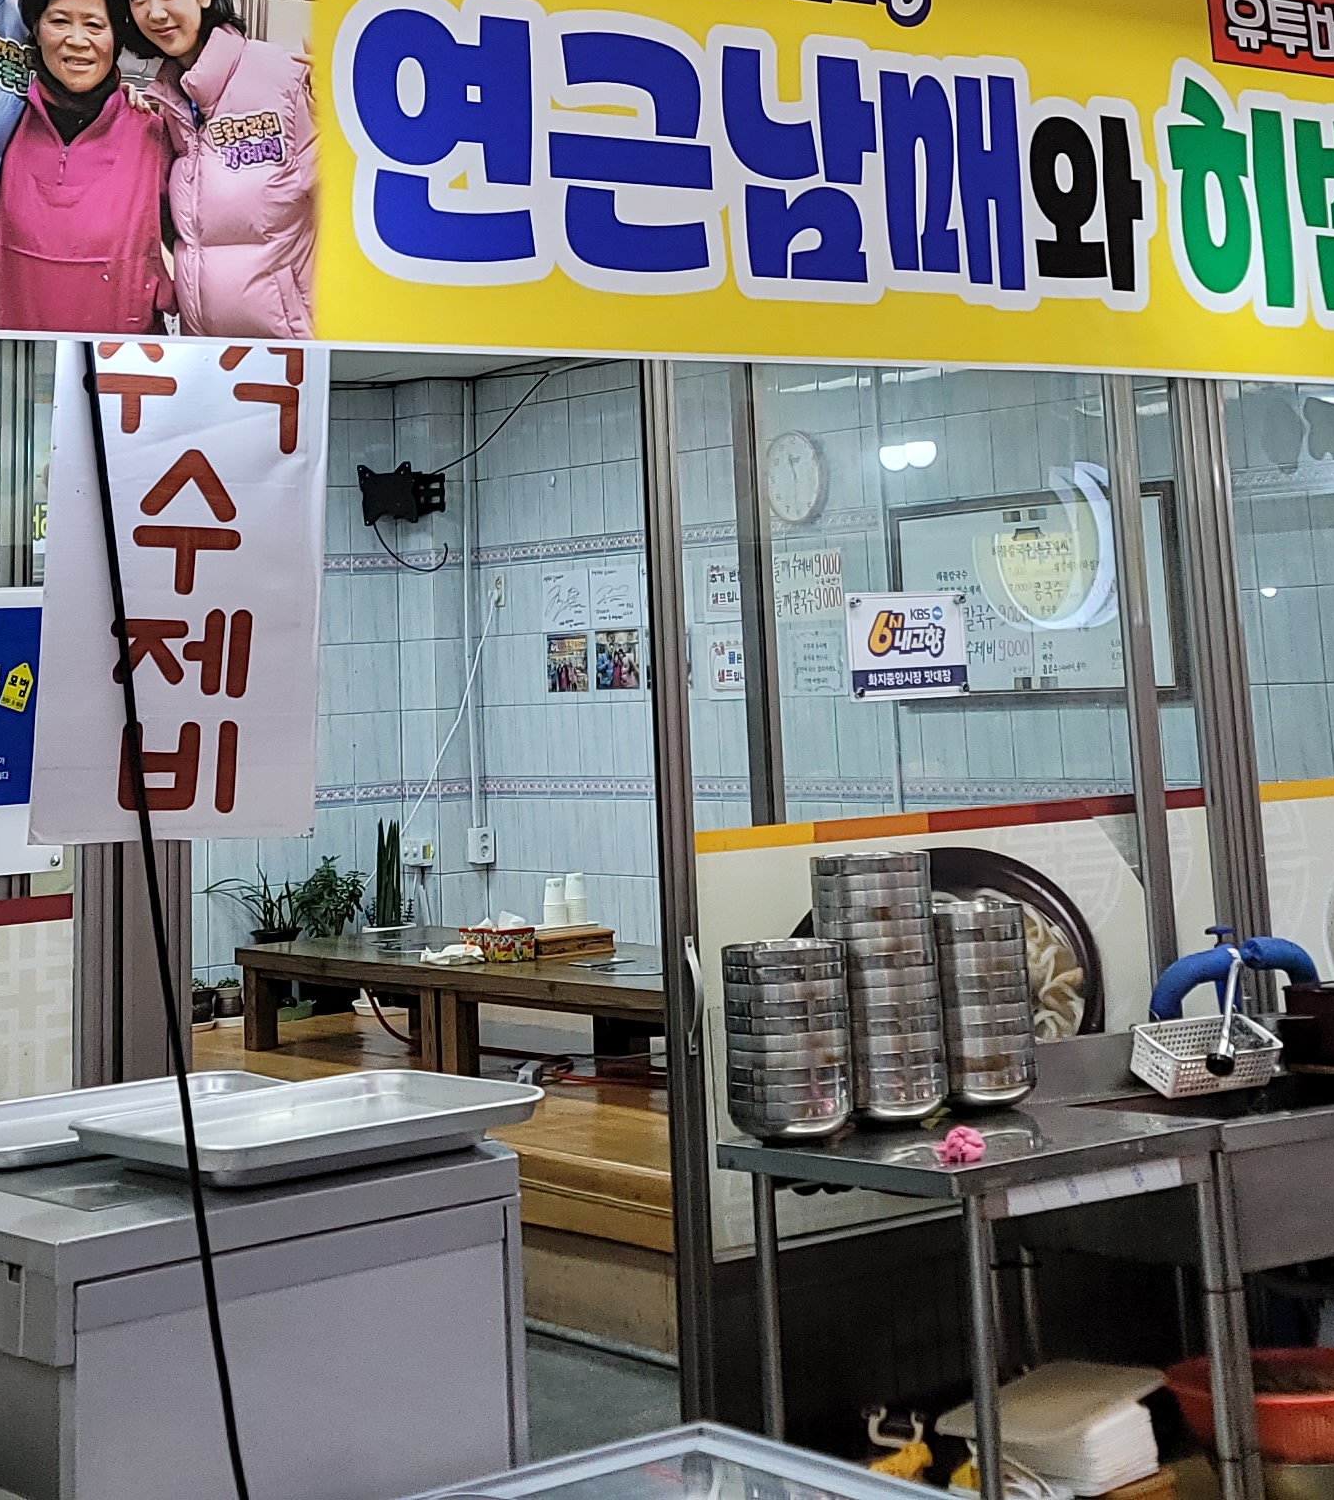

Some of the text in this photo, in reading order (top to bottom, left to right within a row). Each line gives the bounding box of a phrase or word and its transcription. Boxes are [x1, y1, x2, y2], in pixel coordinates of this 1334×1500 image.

[353, 8, 1143, 292] 연근남매와
[112, 448, 253, 814] 수제비
[868, 669, 951, 686] 화지중앙시장 맛대장
[910, 609, 930, 620] KBS
